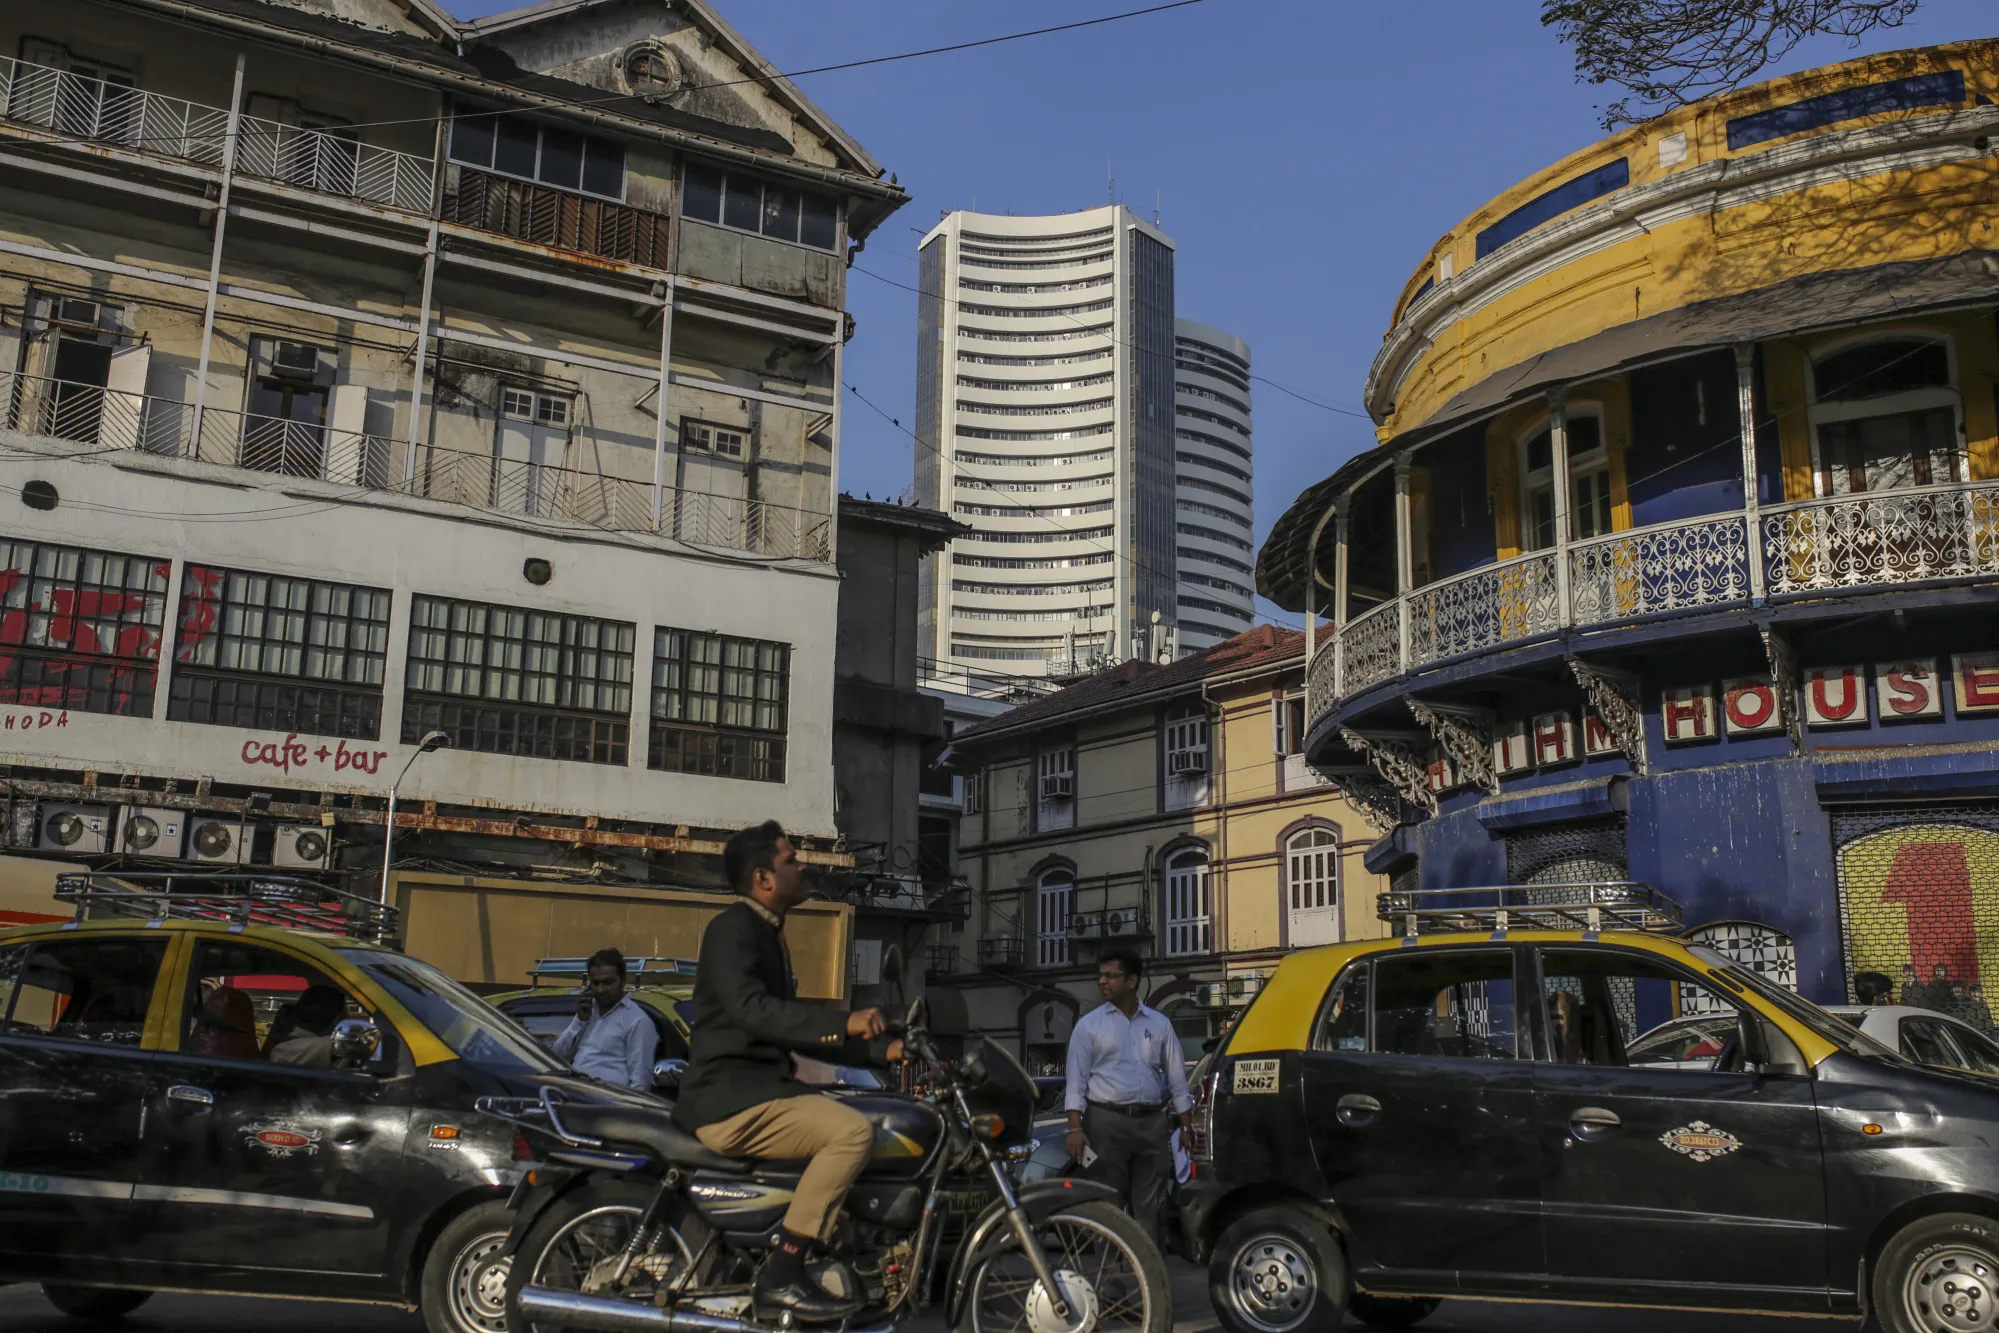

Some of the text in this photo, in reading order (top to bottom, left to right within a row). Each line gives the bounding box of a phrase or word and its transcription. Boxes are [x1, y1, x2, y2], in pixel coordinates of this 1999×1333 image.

[1665, 660, 1999, 739] HOUSE
[0, 710, 69, 731] HODA
[241, 733, 308, 776] cafe
[334, 739, 388, 775] bar
[1236, 1076, 1275, 1089] 3867
